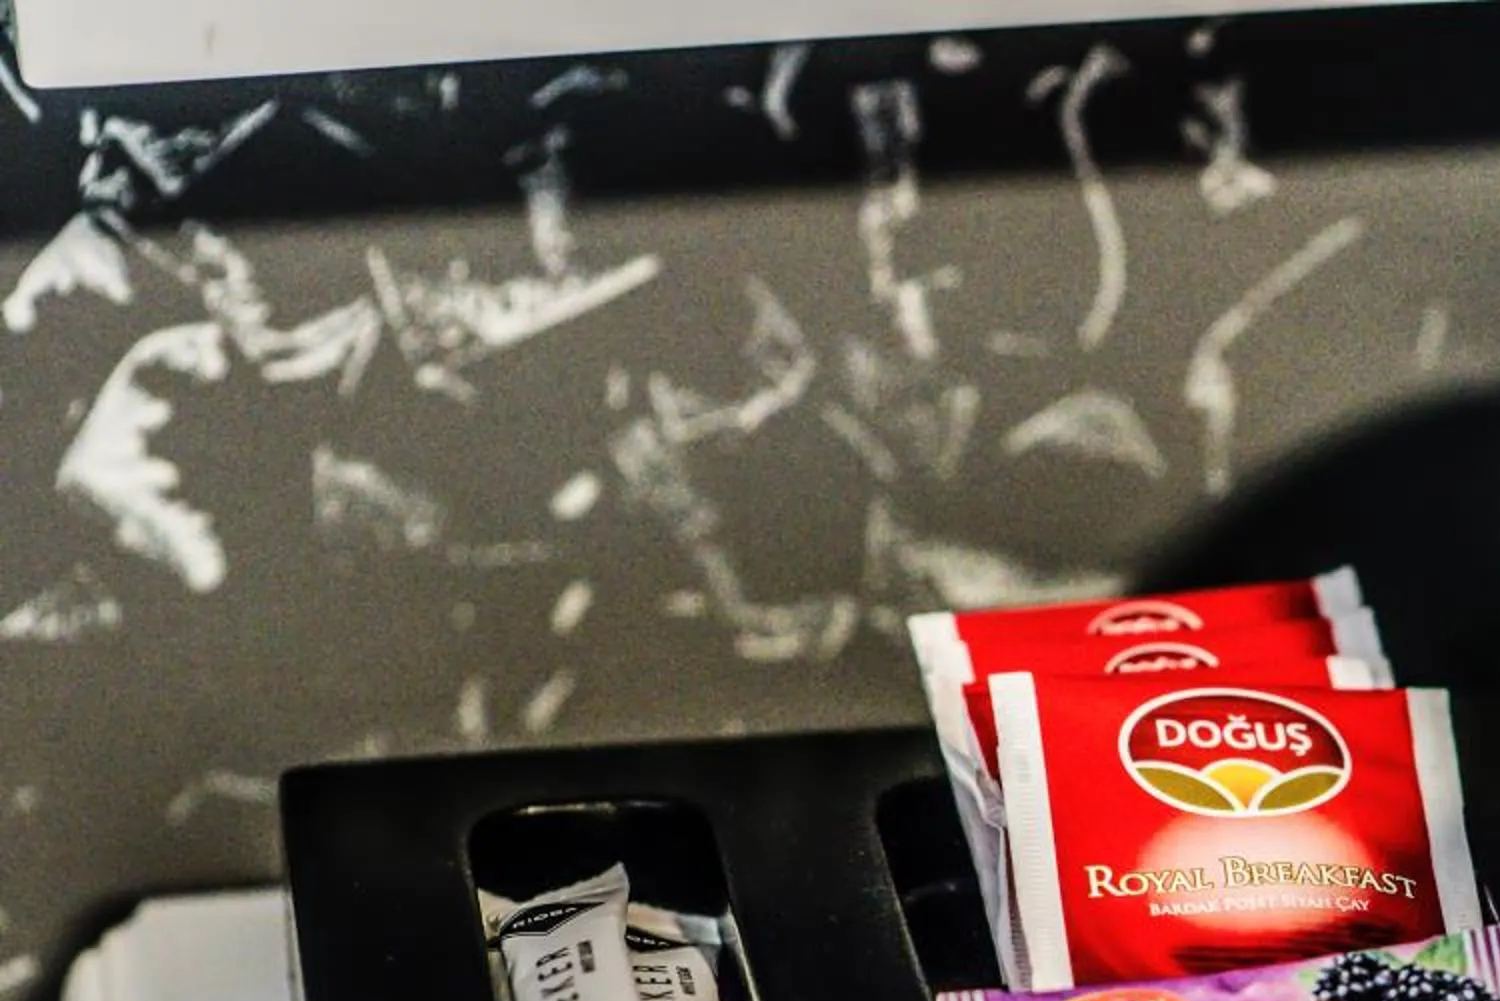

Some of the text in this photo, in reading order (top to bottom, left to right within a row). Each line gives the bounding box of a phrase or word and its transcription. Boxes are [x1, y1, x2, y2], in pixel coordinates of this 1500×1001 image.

[1155, 713, 1313, 757] DOĞUŞ
[1084, 855, 1417, 899] ROYAL BREAKFAST
